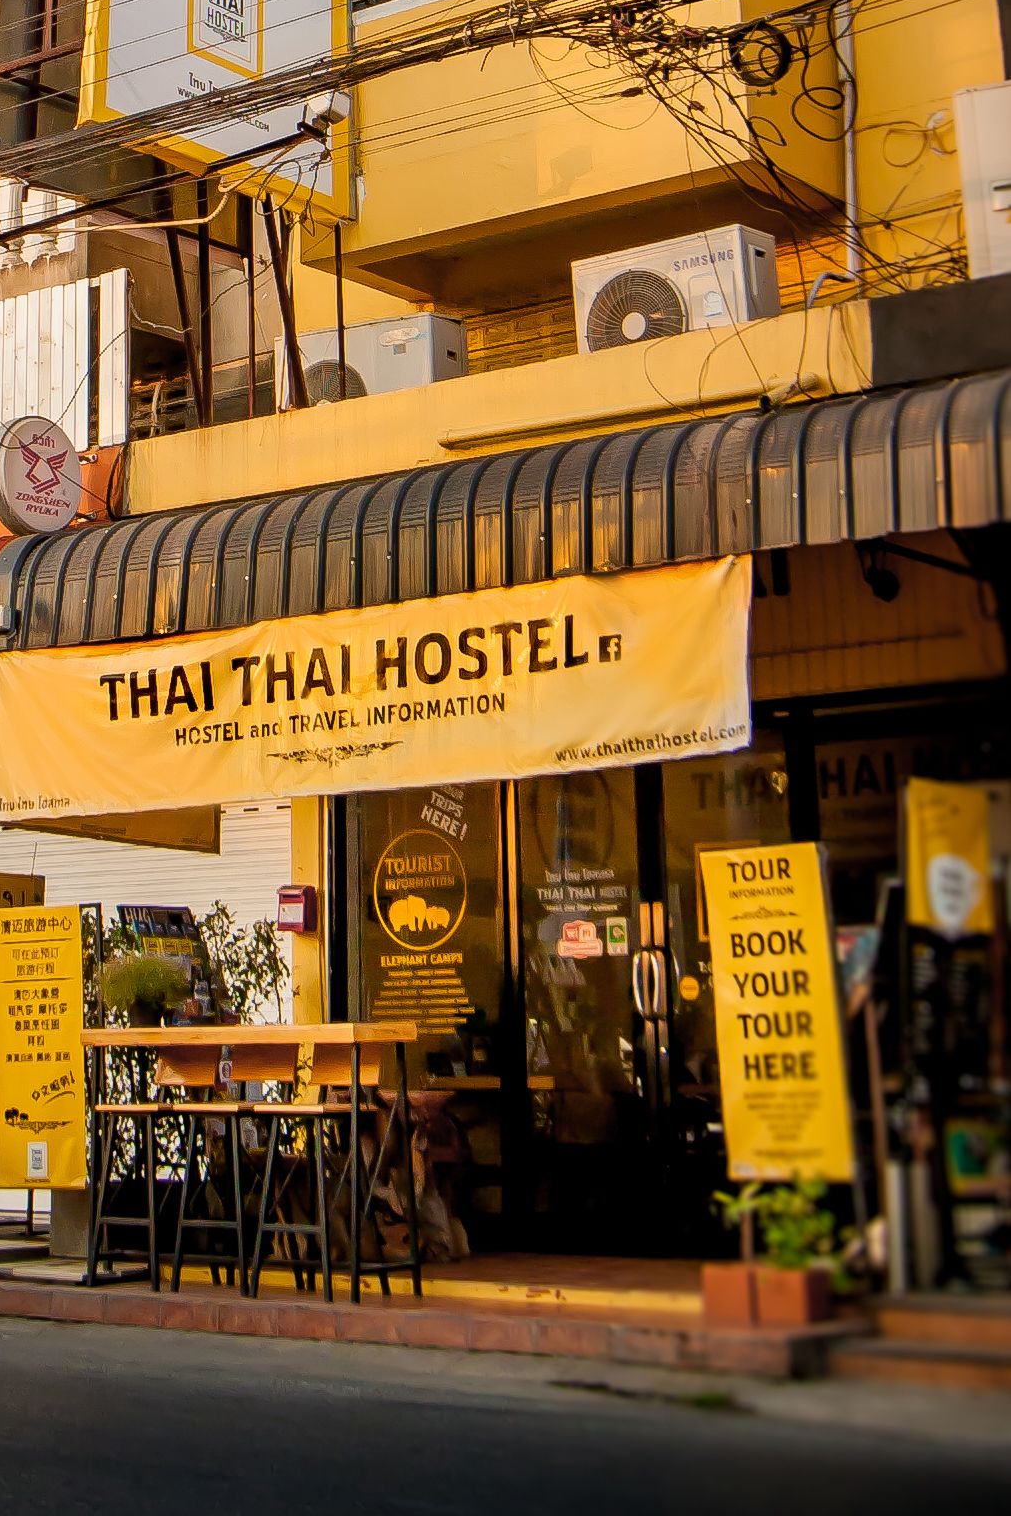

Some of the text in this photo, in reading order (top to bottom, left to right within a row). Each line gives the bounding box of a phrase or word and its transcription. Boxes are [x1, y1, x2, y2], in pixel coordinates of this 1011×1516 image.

[207, 7, 245, 38] HOSTEL
[673, 249, 734, 272] SAMSUNG
[15, 492, 71, 508] ZONGSHEN
[26, 504, 59, 517] RYUKA
[100, 661, 214, 721] THAI
[232, 644, 351, 706] THAI
[376, 614, 589, 690] HOSTEL
[175, 692, 505, 747] HOSTEL and TRAVEL INFORMATION
[555, 723, 747, 762] www.thaithaihostel.com
[384, 855, 451, 875] TOURIST
[727, 858, 791, 883] TOUR
[729, 885, 794, 899] INFORMATION
[730, 929, 807, 958] BOOK
[381, 954, 426, 967] ELEPHANT
[733, 970, 810, 998] YOUR
[737, 1011, 814, 1039] TOUR
[744, 1052, 817, 1081] HERE
